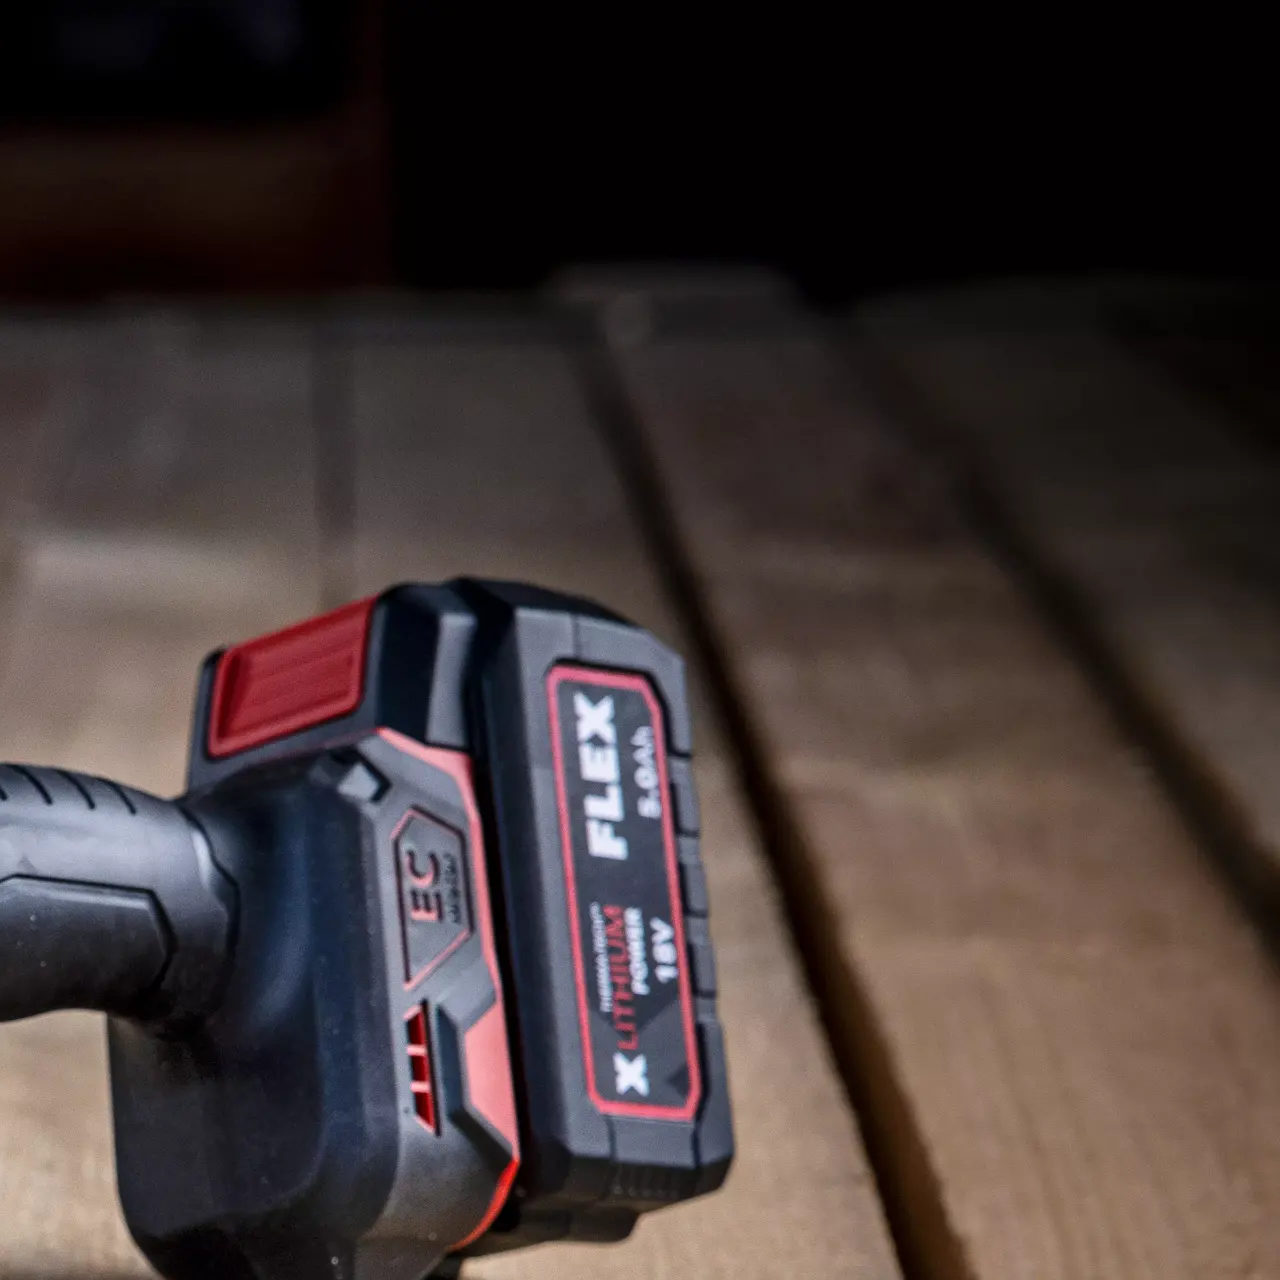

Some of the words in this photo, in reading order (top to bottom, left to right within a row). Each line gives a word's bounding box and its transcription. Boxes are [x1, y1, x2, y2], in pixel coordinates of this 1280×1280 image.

[573, 691, 629, 861] FLEX
[405, 850, 444, 922] EC
[603, 905, 639, 1050] LITHIUM
[624, 907, 650, 995] POWER
[650, 917, 679, 983] 18V
